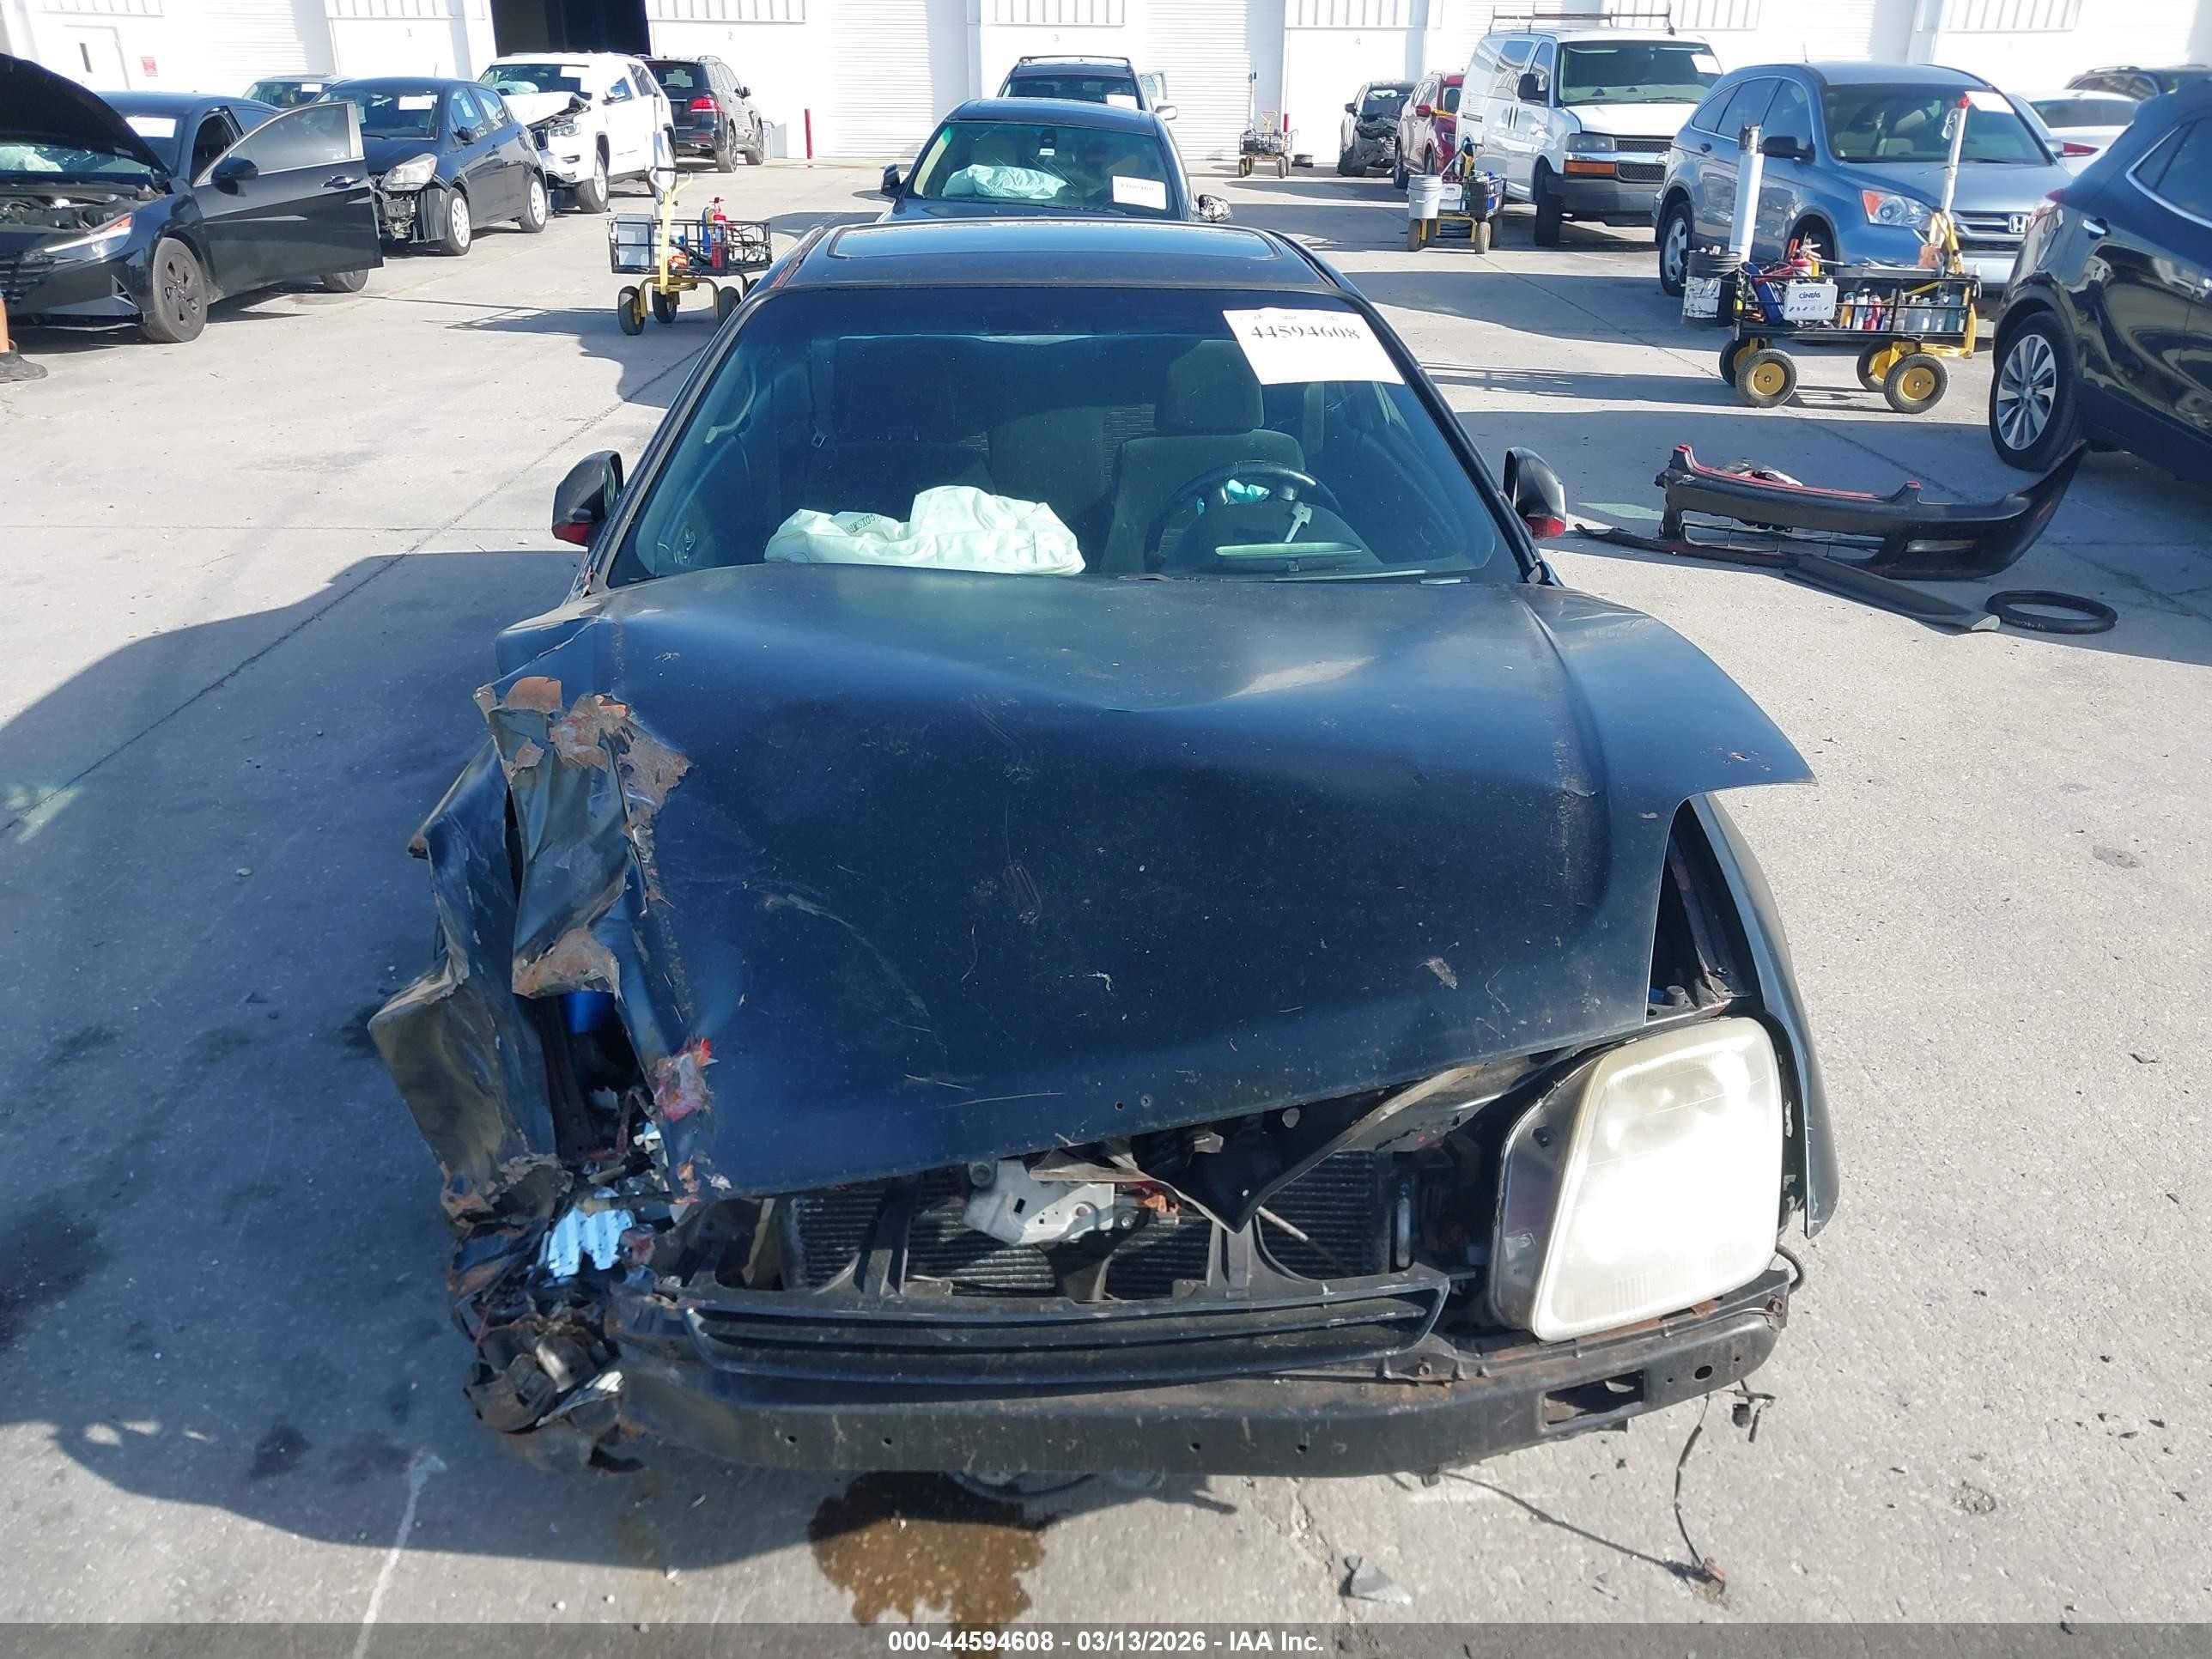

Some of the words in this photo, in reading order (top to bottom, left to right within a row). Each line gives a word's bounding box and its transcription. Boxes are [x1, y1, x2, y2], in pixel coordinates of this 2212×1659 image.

[727, 31, 733, 40] 2
[1054, 33, 1060, 42] 3
[1251, 325, 1361, 339] 44594608
